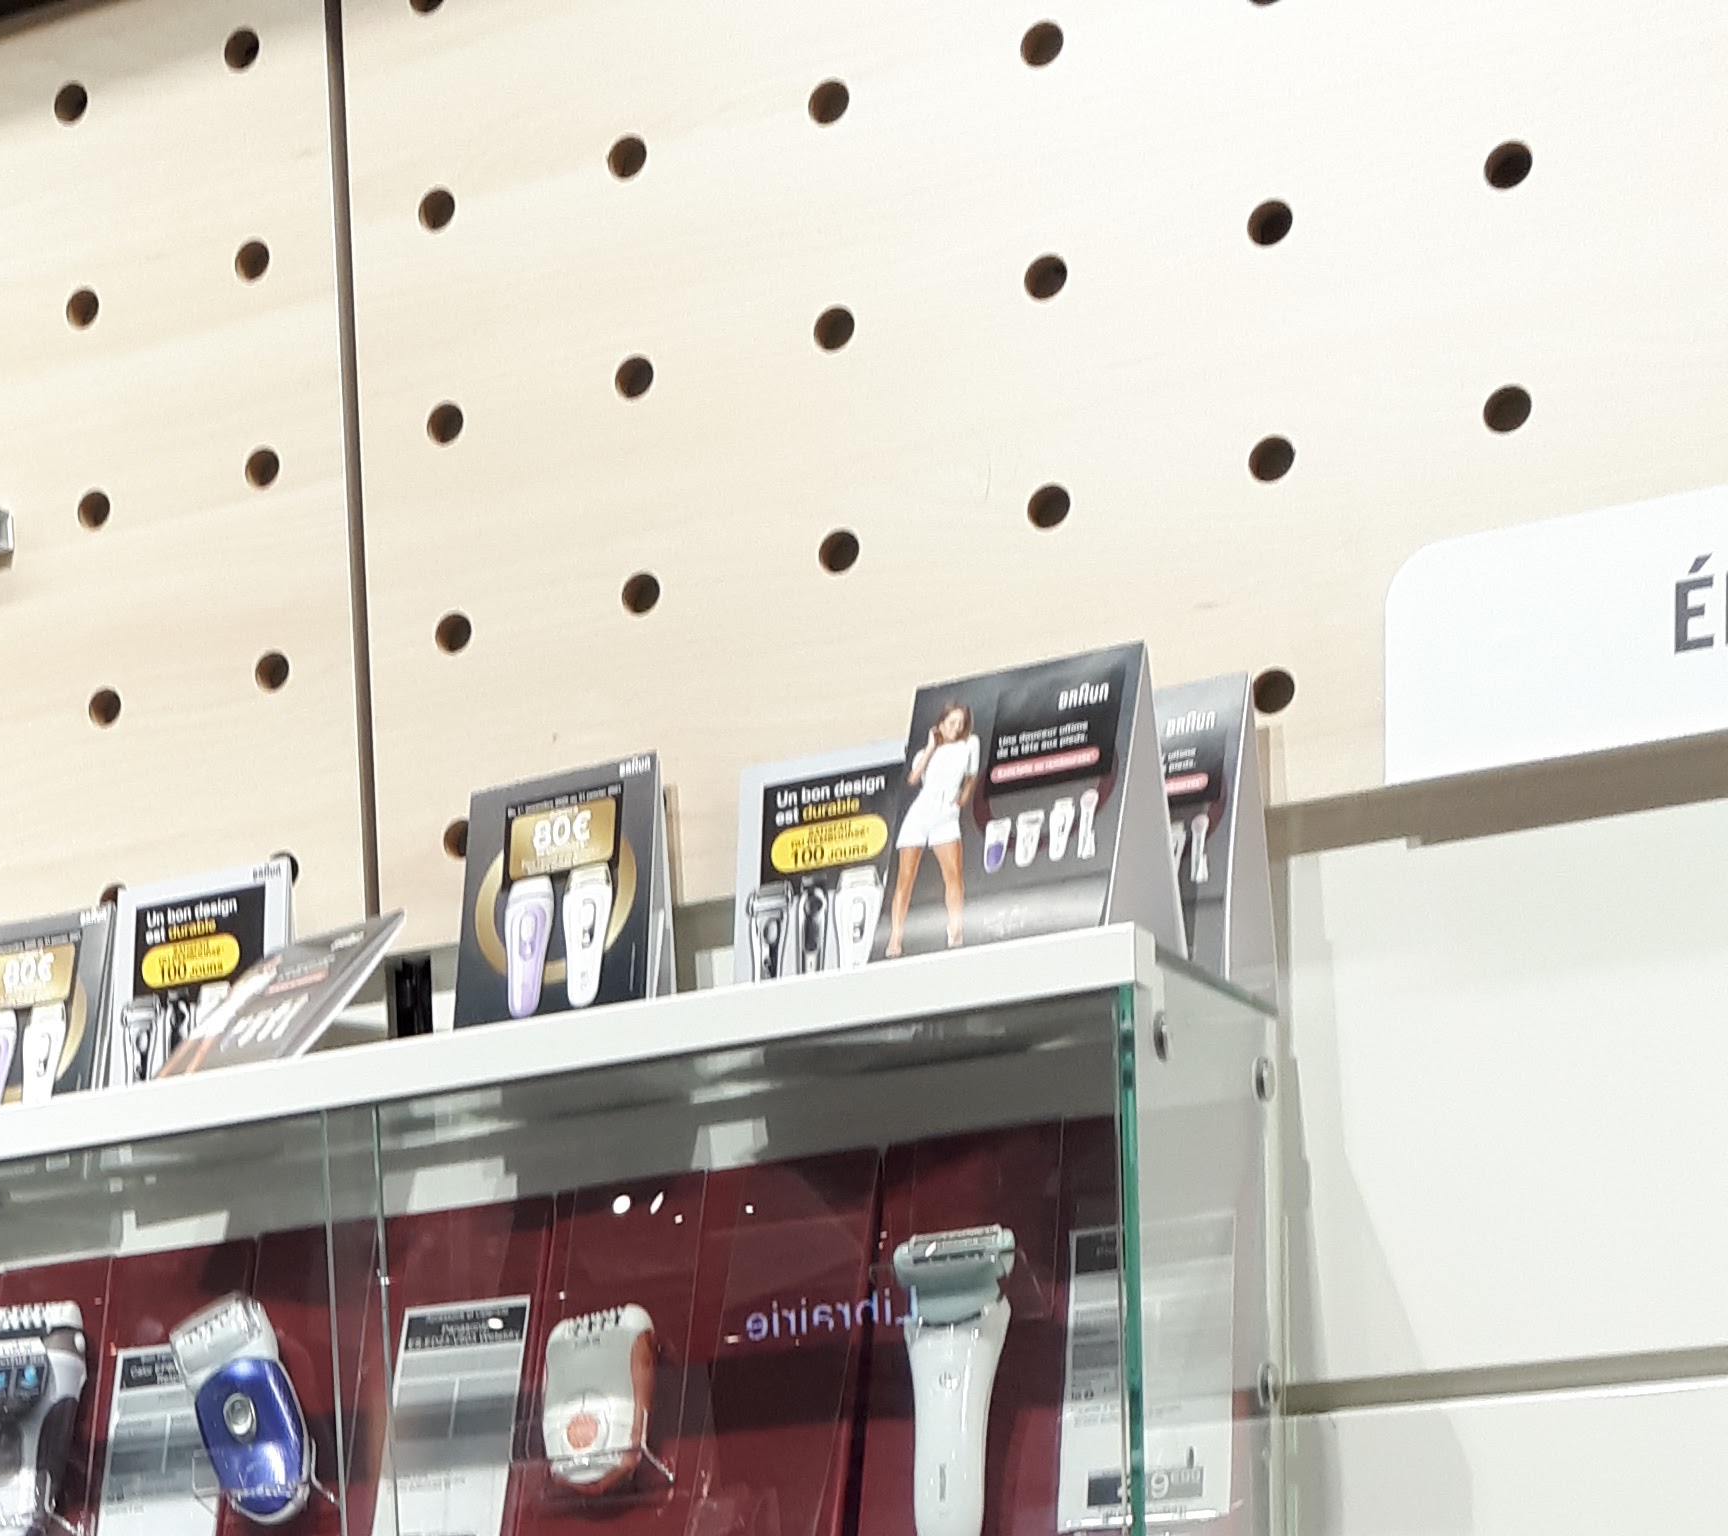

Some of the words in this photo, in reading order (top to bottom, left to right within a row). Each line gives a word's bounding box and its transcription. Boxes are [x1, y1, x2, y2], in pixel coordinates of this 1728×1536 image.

[776, 790, 797, 810] Un
[801, 784, 831, 804] bon
[834, 775, 885, 797] design
[803, 797, 860, 821] durable
[533, 810, 591, 851] 80€
[790, 844, 824, 869] 100
